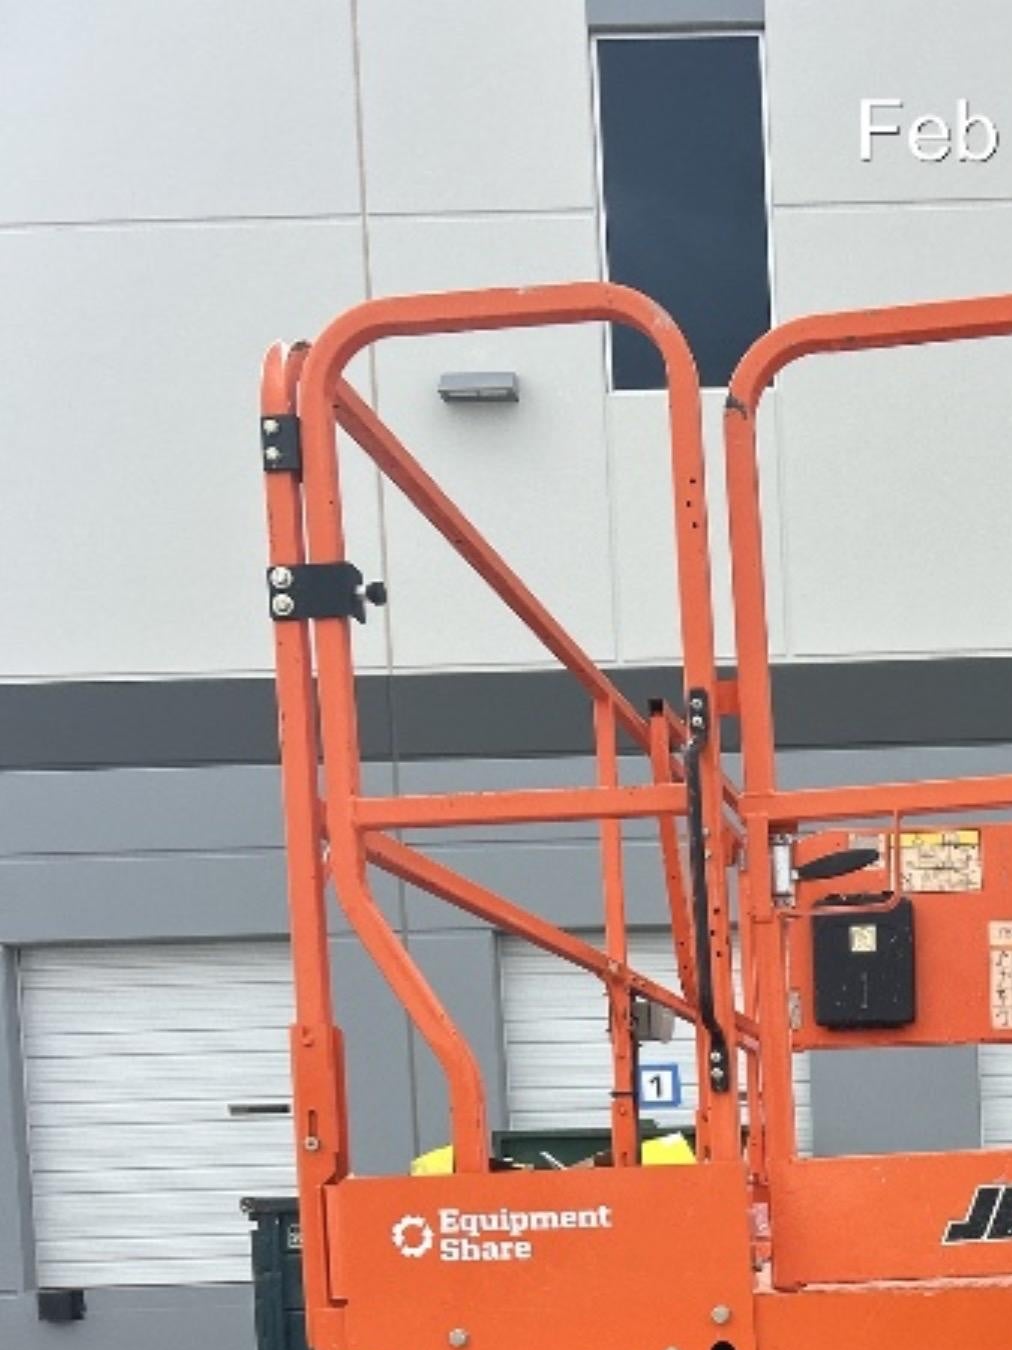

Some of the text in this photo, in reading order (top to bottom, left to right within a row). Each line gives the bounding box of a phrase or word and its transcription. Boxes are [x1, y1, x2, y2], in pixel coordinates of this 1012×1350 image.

[649, 1074, 661, 1098] 1
[438, 1205, 613, 1237] Equipment
[439, 1238, 532, 1262] Share
